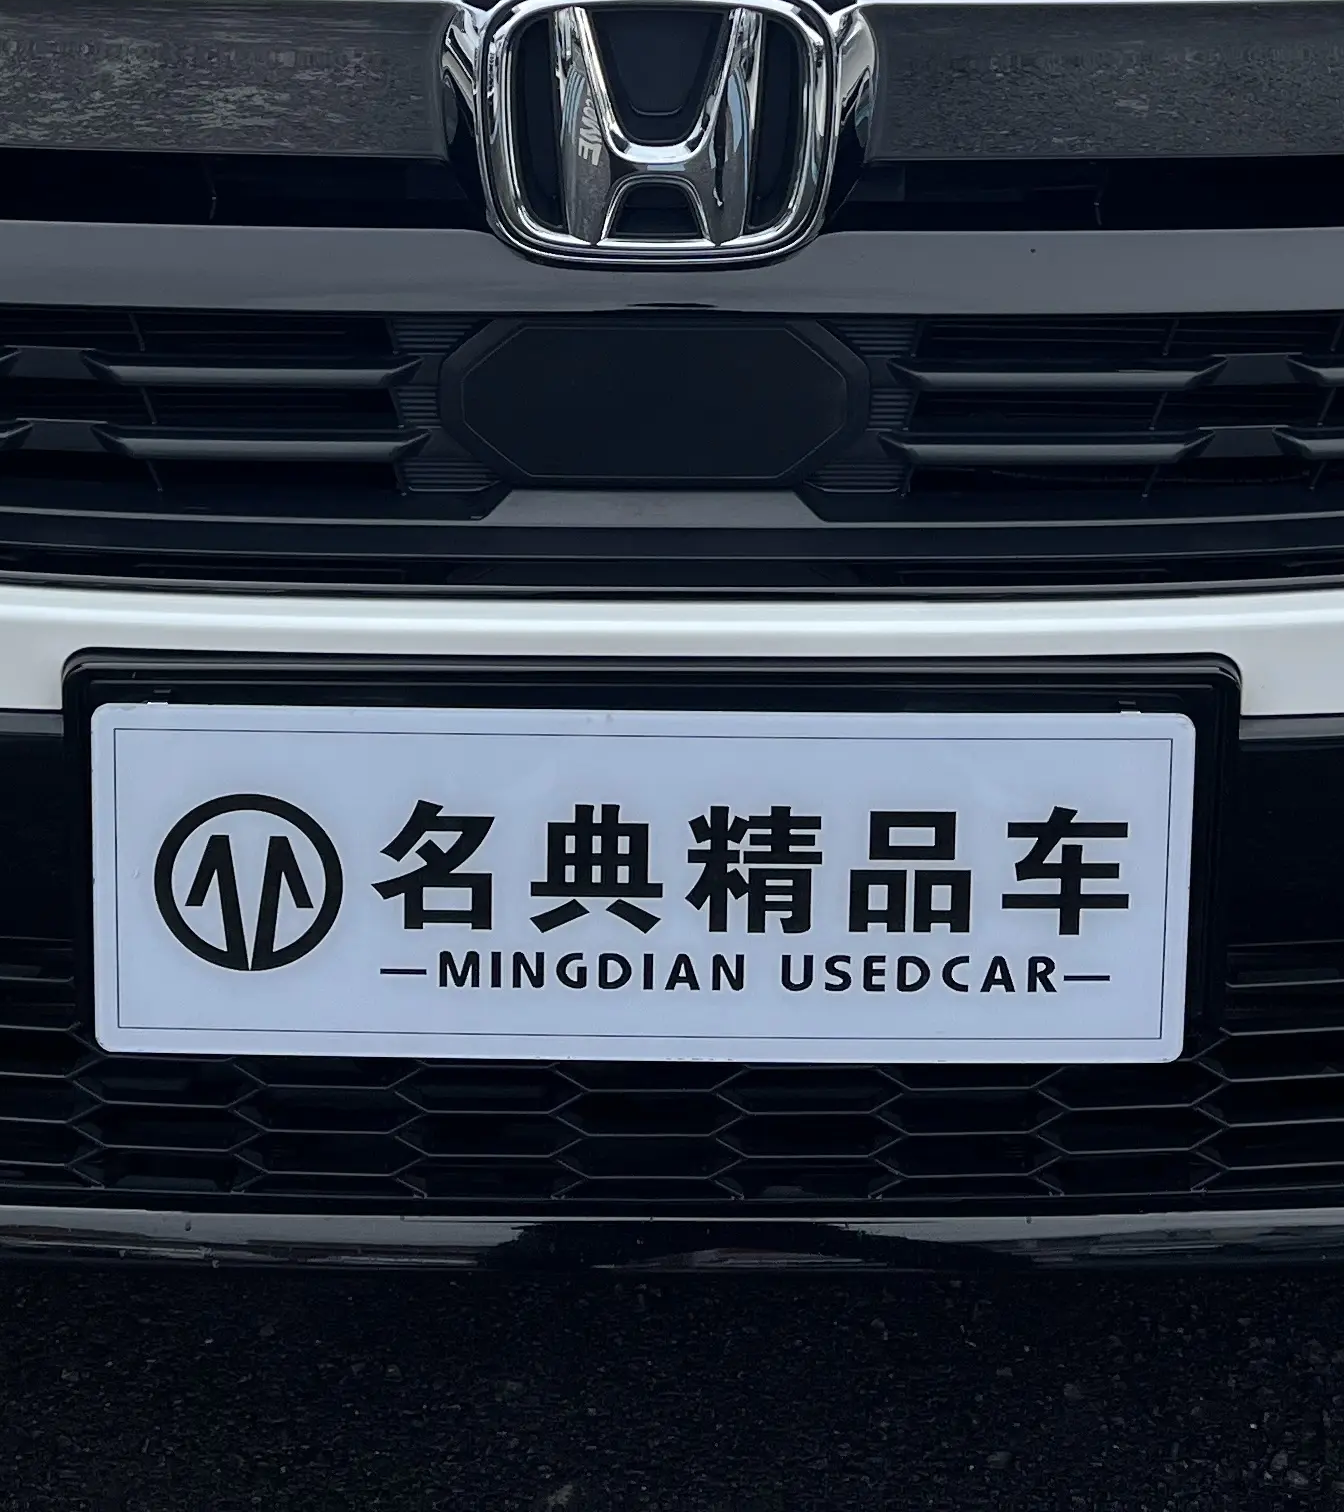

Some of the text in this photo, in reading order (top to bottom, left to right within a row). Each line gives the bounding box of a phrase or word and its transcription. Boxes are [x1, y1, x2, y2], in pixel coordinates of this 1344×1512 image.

[372, 799, 1131, 936] 名典精品车
